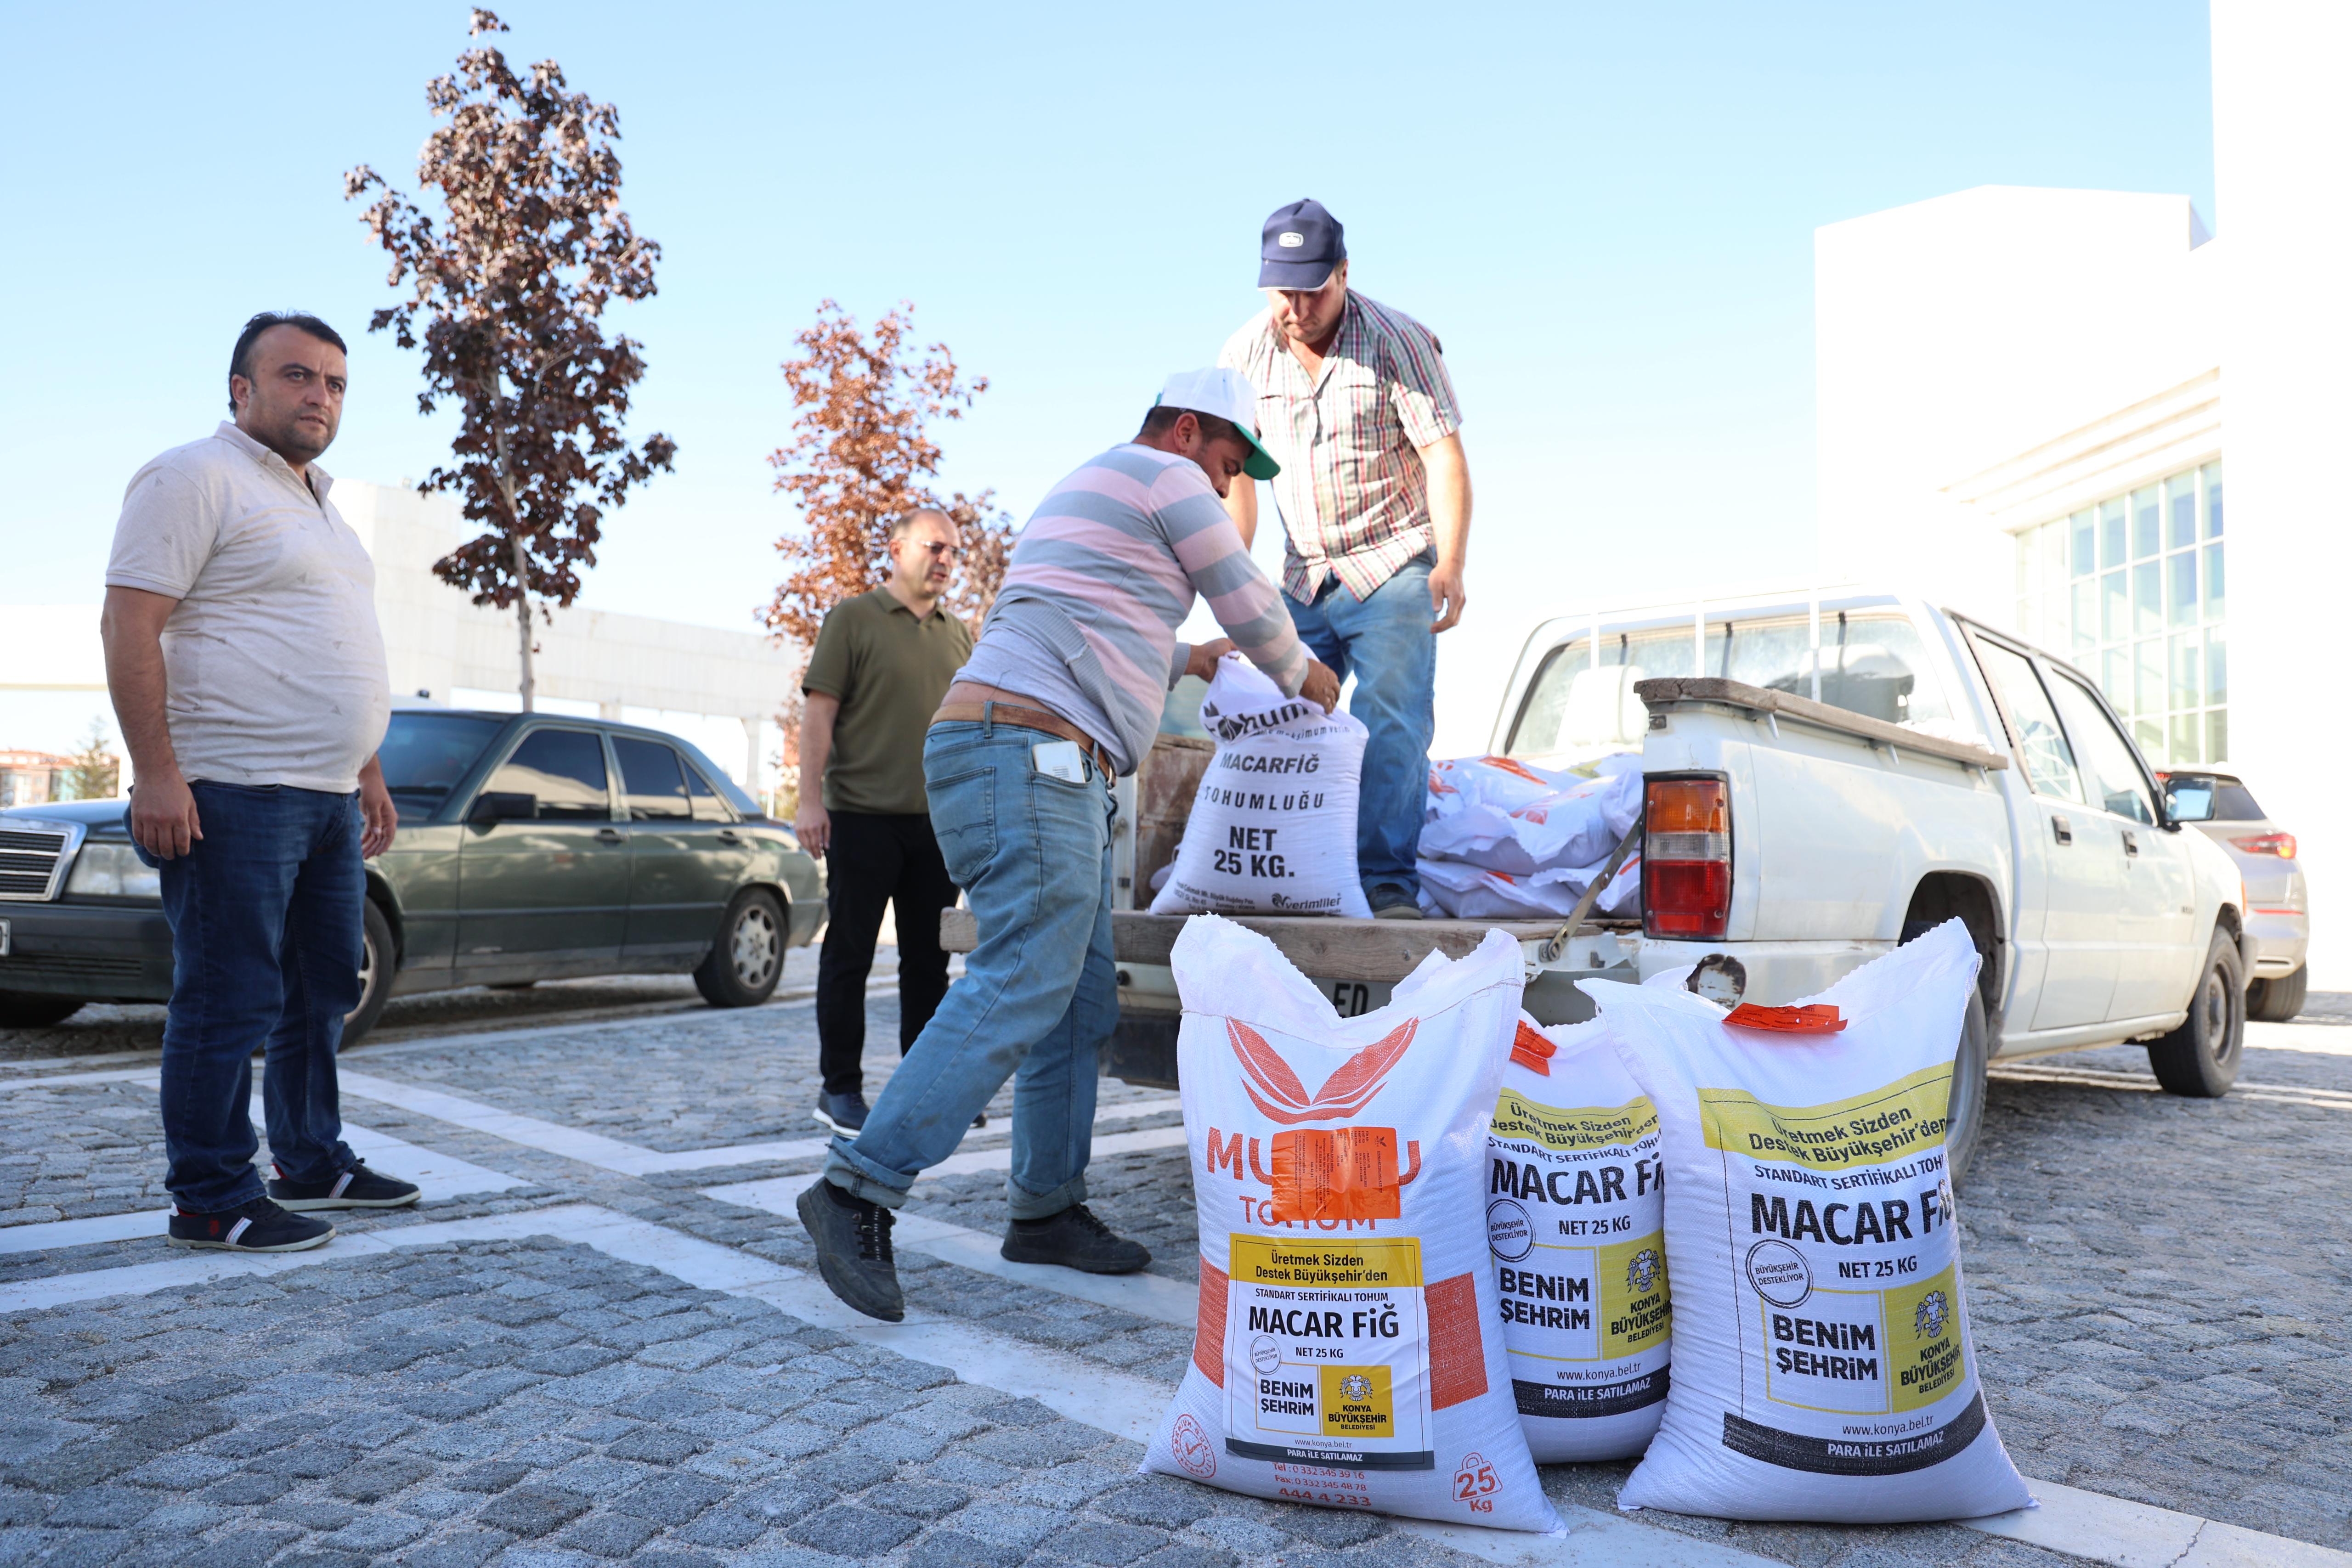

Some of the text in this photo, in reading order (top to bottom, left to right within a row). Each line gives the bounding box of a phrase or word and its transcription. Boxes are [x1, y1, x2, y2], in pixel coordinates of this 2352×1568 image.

[1205, 786, 1324, 810] TOHUMLUĞU
[1229, 826, 1277, 851] NET
[1214, 849, 1295, 878] 25 KG.
[1510, 1102, 1631, 1132] Üretmek Sizden
[1771, 1108, 1912, 1145] Üretmek Sizden
[1488, 1128, 1662, 1163] STANDART SERTİFİKALI TOHU
[1749, 1133, 1811, 1161] Destek
[1491, 1152, 1665, 1205] MACAR Fi
[1754, 1154, 1943, 1190] STANDART SERTİFİKALI TOH
[1559, 1215, 1631, 1235] NET 25 KG
[1752, 1193, 1913, 1245] MACAR
[1271, 1249, 1364, 1268] Üretmek Sizden
[1755, 1261, 1799, 1275] BÜYÜKŞEHİR
[1839, 1255, 1917, 1279] NET 25 KG
[1256, 1265, 1388, 1283] Destek Büyükşehir'den
[1758, 1272, 1804, 1286] DESTEKLİYOR
[1255, 1288, 1389, 1303] STANDART SERTİFİKALI TOHUM
[1631, 1292, 1660, 1313] KONYA
[1249, 1306, 1344, 1337] MACAR
[1611, 1299, 1672, 1335] BÜYÜKŞEHİR
[1628, 1320, 1664, 1342] BELEDİYESİ
[1295, 1347, 1344, 1358] NET 25 KG
[1920, 1337, 1950, 1362] KONYA
[1557, 1362, 1640, 1381] www.konya.bel.tr
[1901, 1343, 1960, 1386] BÜYÜKŞEHİR
[1544, 1388, 1574, 1401] PARA
[1597, 1377, 1651, 1399] SATILAMAZ
[1919, 1365, 1955, 1393] BELEDİYESİ
[1328, 1411, 1387, 1424] BÜYÜKŞEHİR
[1340, 1422, 1376, 1431] BELEDİYESİ
[1842, 1415, 1934, 1440] www.konya.bel.tr
[1287, 1449, 1306, 1458] PARA
[1321, 1451, 1363, 1461] SATILAMAZ
[1295, 1438, 1352, 1449] www.konya.bel.tr
[1828, 1444, 1861, 1457] PARA
[1885, 1430, 1944, 1457] SATILAMAZ
[1301, 1466, 1317, 1475] 332
[1319, 1468, 1337, 1477] 345
[1339, 1469, 1351, 1478] 39
[1457, 1466, 1496, 1499] 25
[1278, 1487, 1372, 1506] 444 4 233
[1303, 1478, 1320, 1487] 332
[1322, 1479, 1339, 1489] 345
[1355, 1483, 1367, 1491] 78
[1470, 1500, 1493, 1513] Kg
